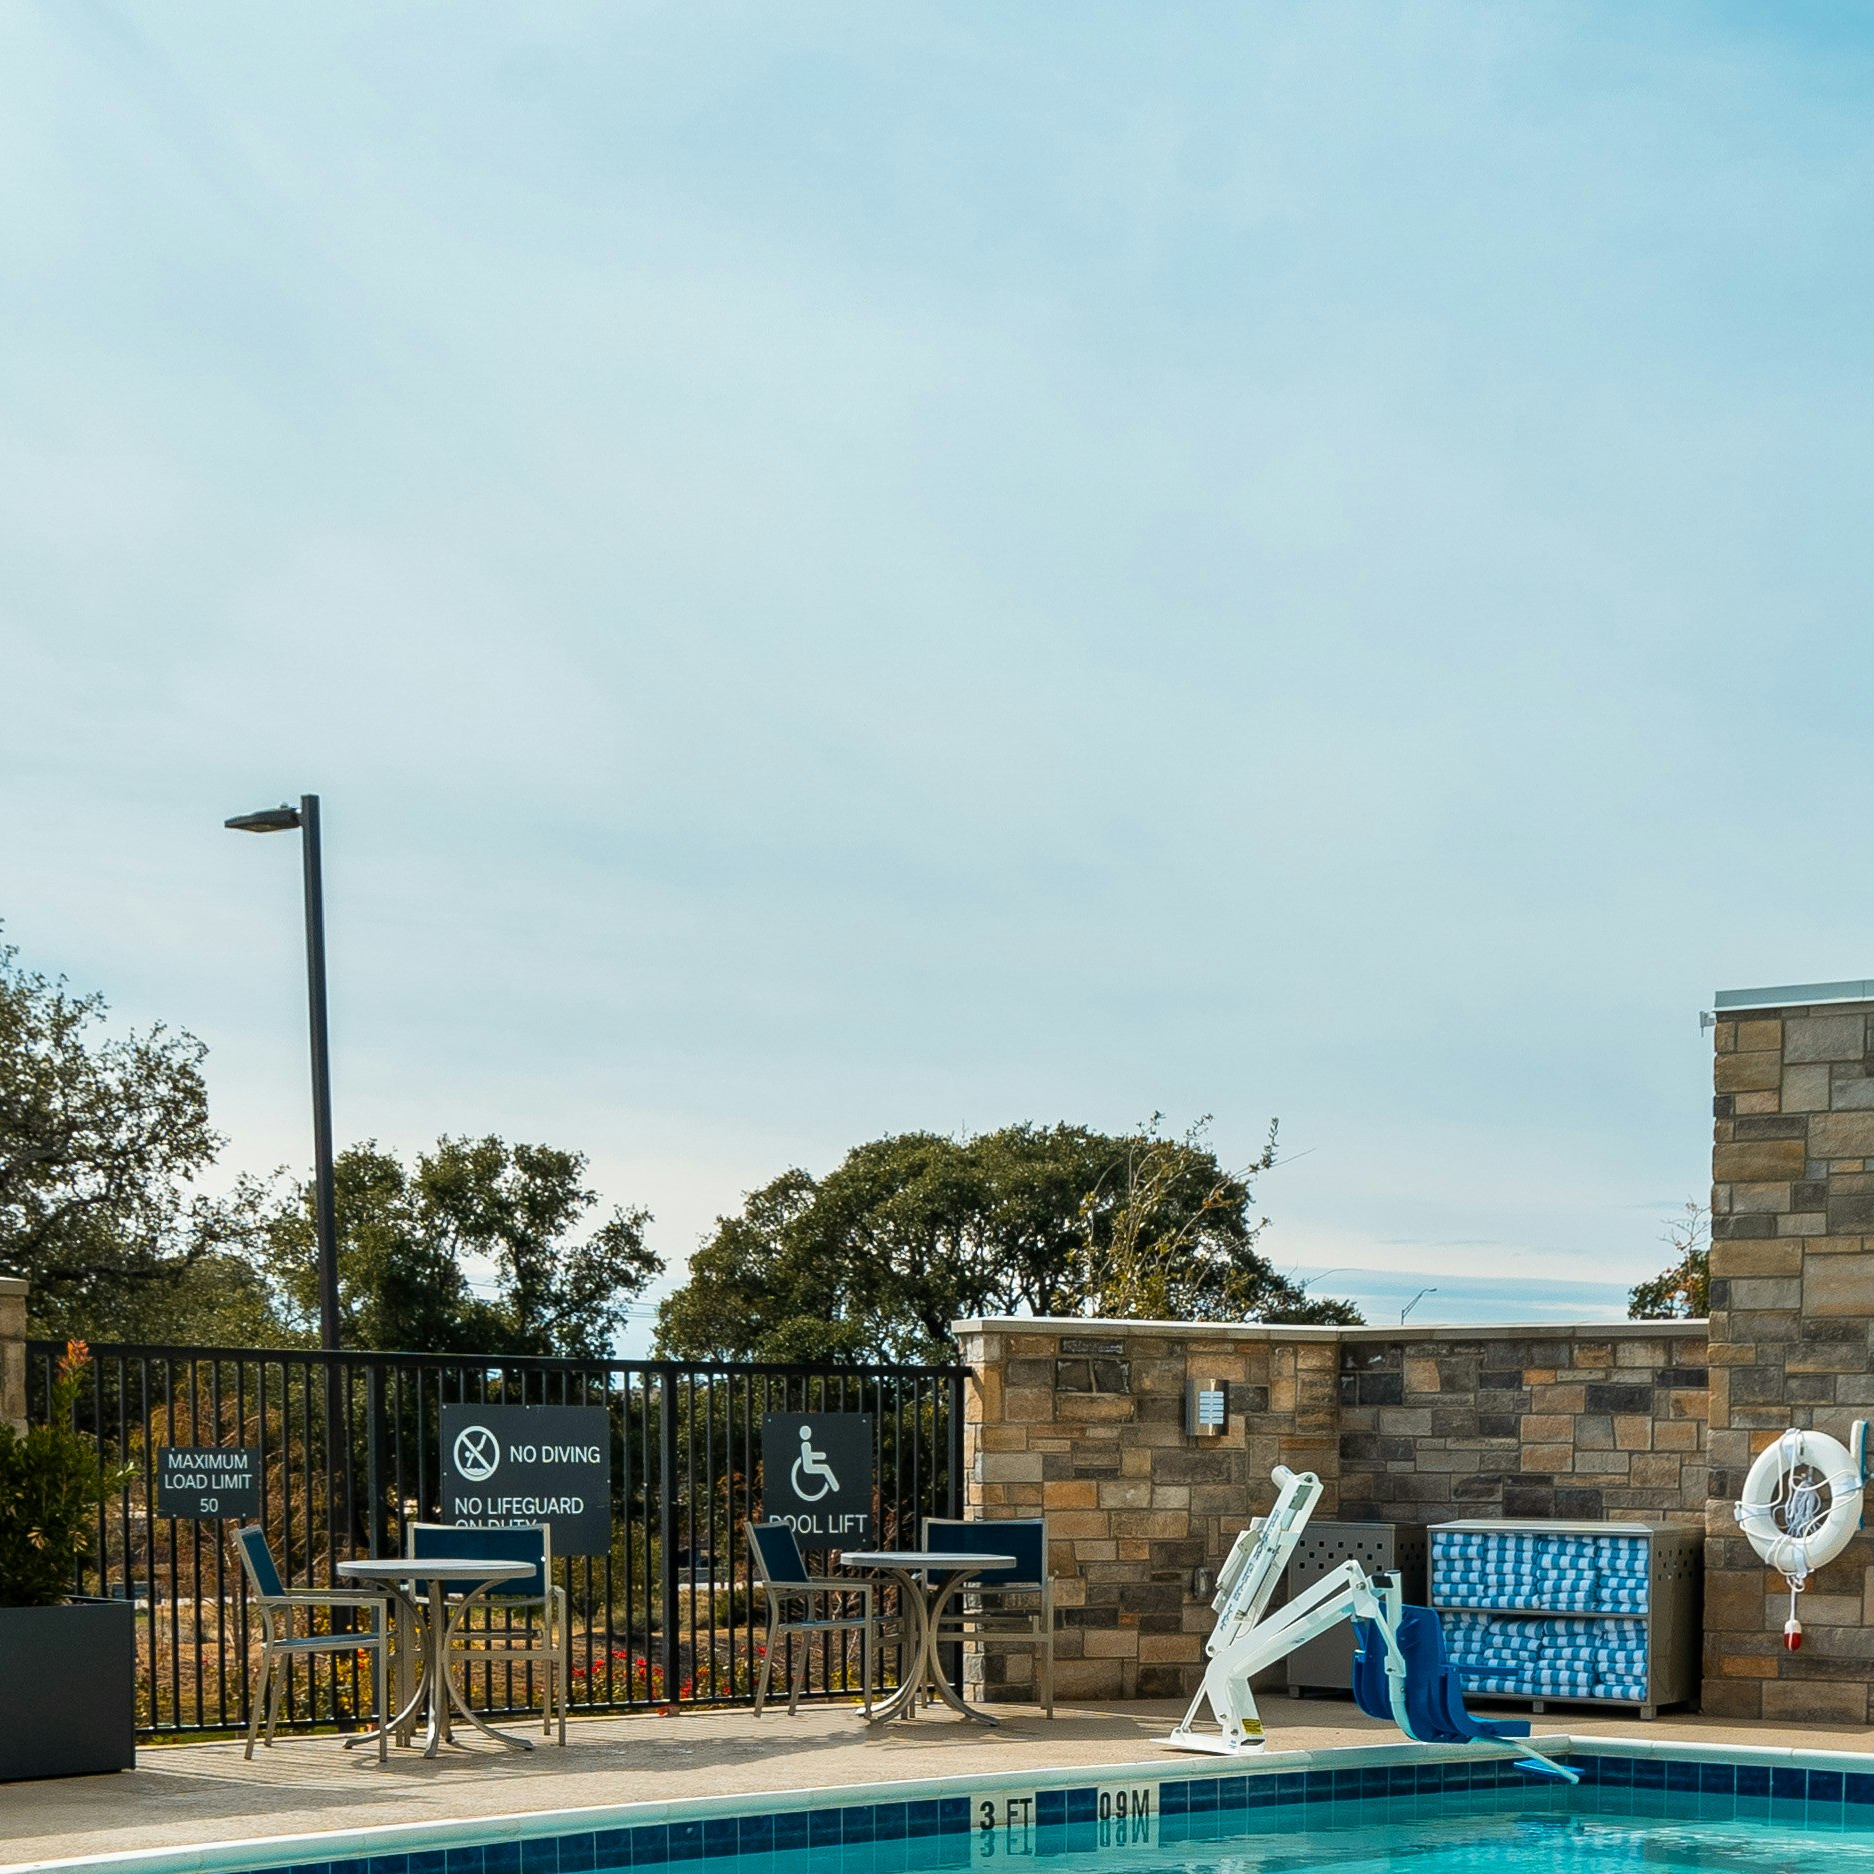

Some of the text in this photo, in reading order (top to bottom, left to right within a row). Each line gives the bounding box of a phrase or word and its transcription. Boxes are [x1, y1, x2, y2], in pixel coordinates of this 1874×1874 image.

[169, 1454, 247, 1469] MAXIMUM
[510, 1446, 600, 1463] NO DIVING
[165, 1474, 252, 1489] LOAD LIMIT
[201, 1498, 218, 1512] 50
[455, 1497, 583, 1514] NO LIFEGUARD
[829, 1515, 868, 1533] LIFT
[979, 1797, 1033, 1831] 3 FT
